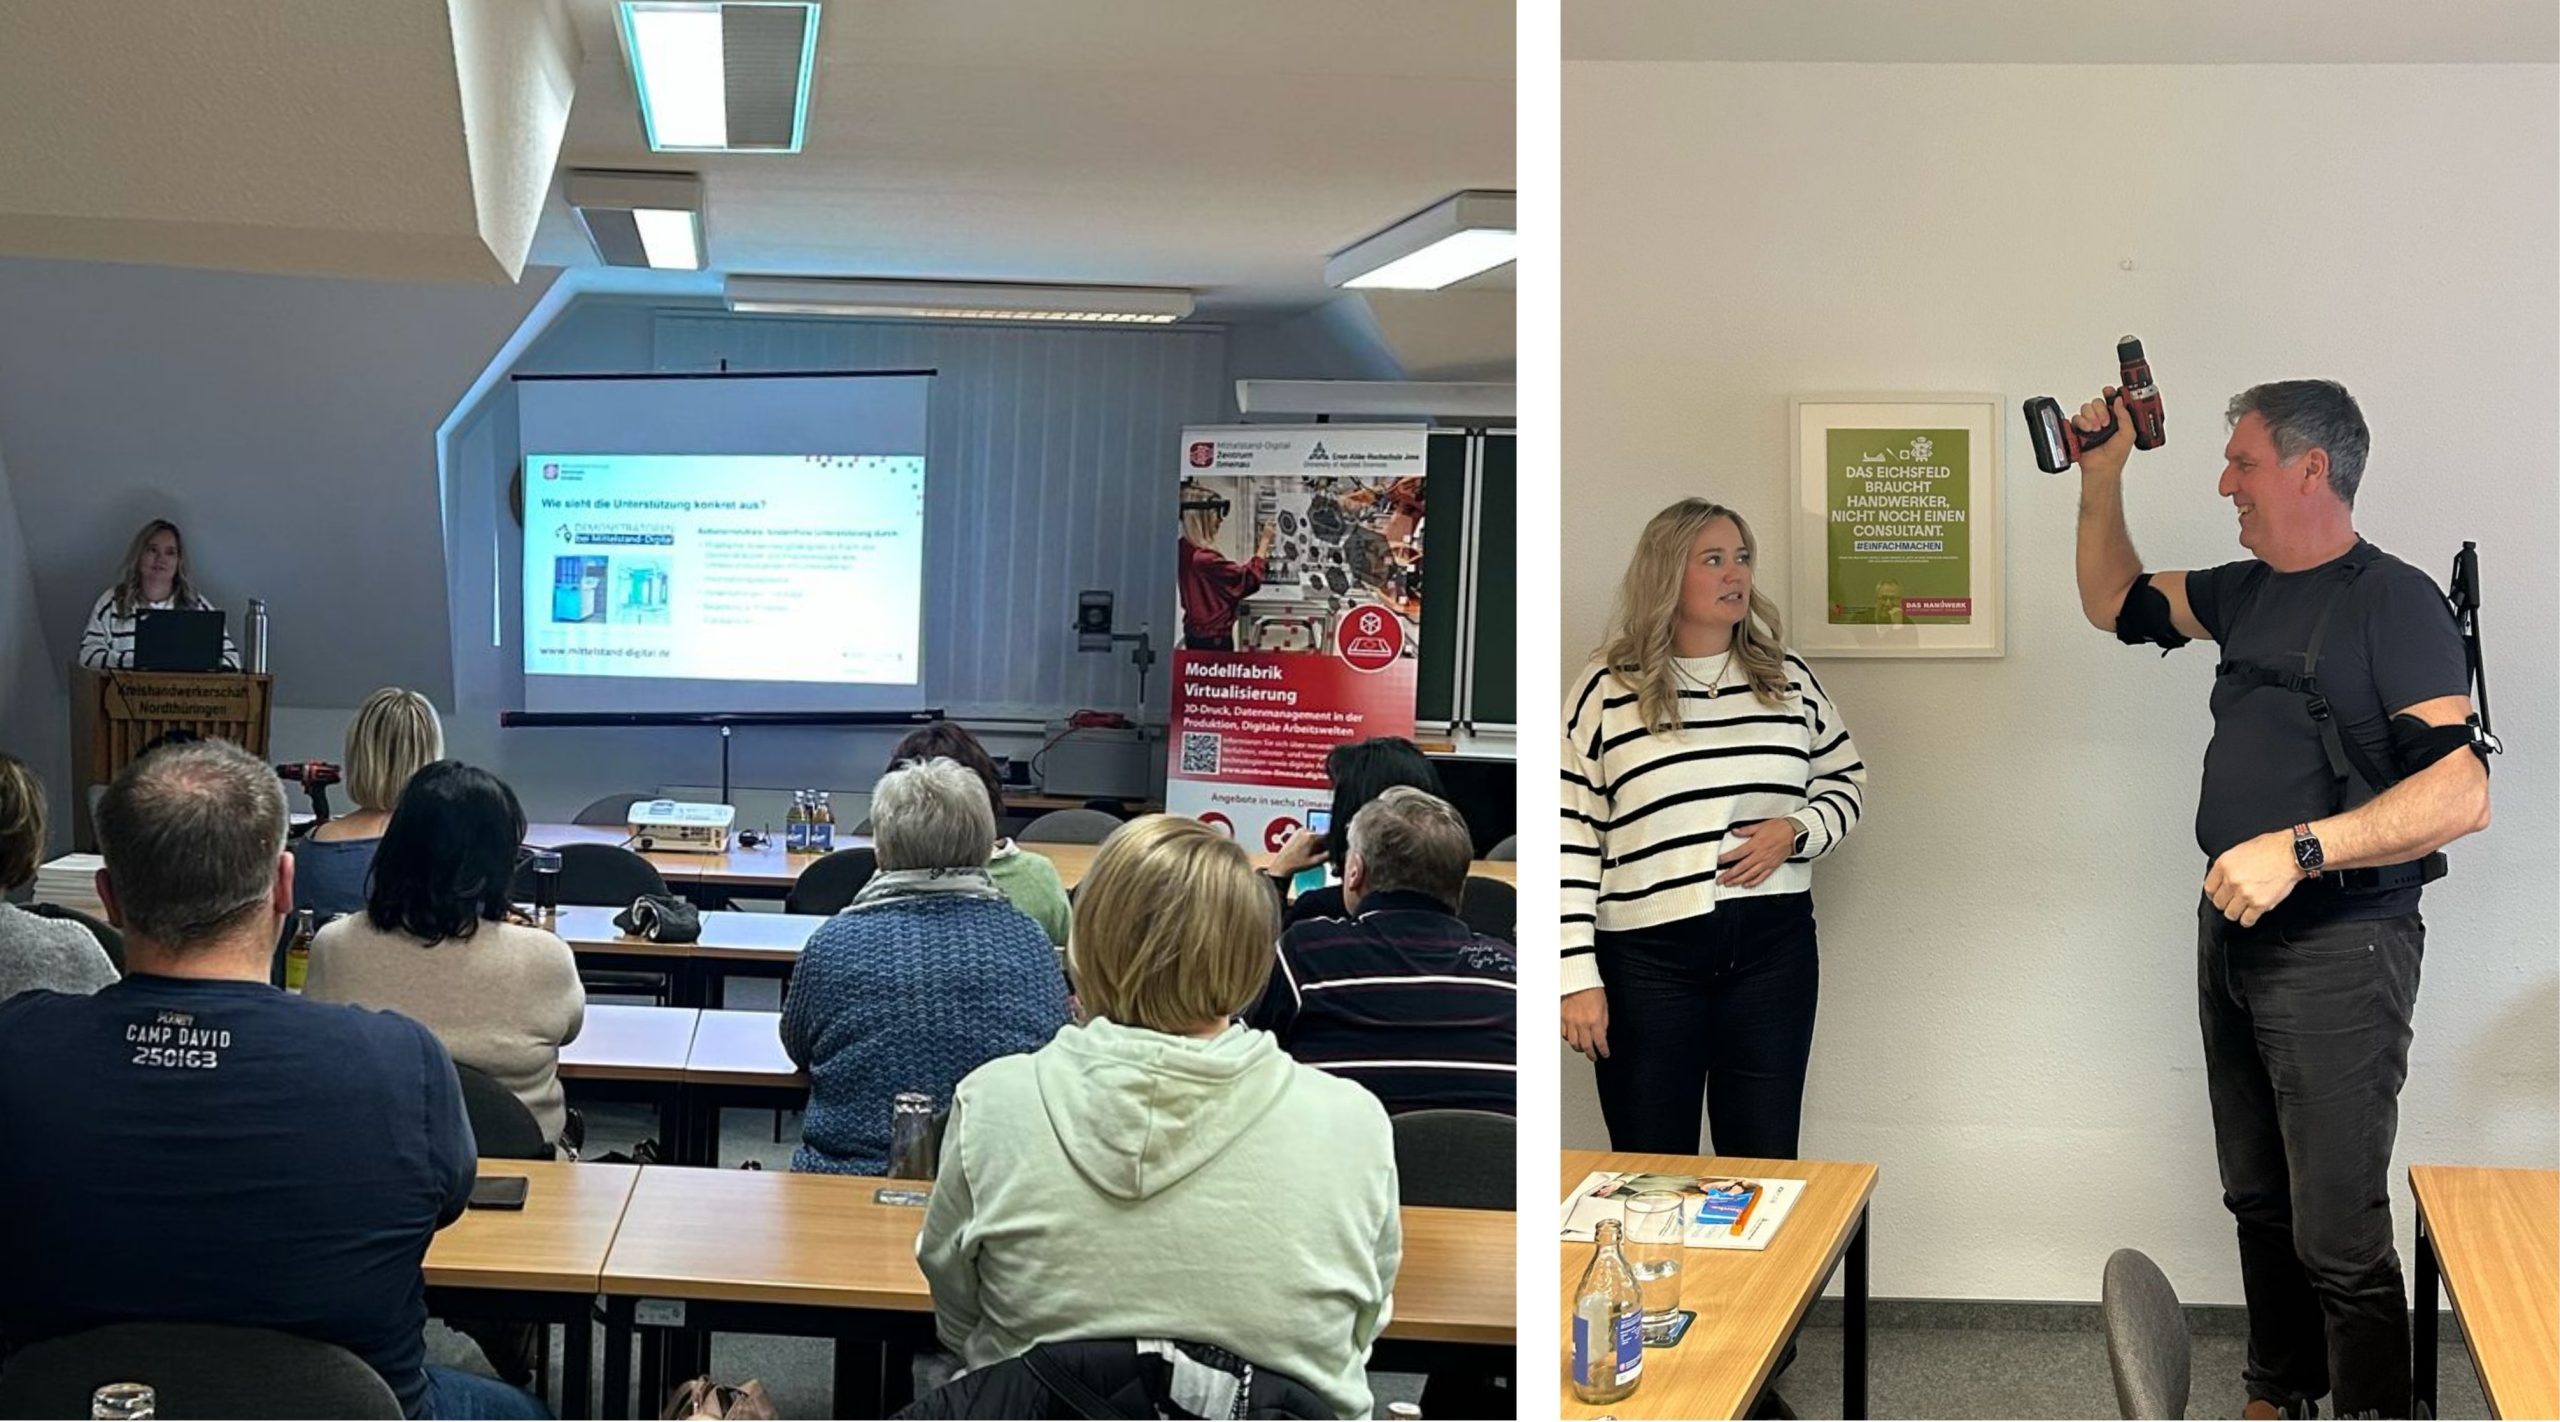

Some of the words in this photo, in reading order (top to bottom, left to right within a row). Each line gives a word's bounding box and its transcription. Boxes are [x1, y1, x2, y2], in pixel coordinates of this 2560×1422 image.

[1216, 442, 1291, 451] Mittelstand-Digital
[1216, 451, 1253, 459] Zentrum
[1846, 466, 1873, 478] DAS
[1877, 466, 1950, 478] EICHSFELD
[1865, 480, 1932, 493] BRAUCHT
[542, 498, 561, 508] Wie
[565, 498, 591, 509] sieht
[594, 498, 611, 509] die
[694, 499, 736, 509] konkret
[1847, 495, 1950, 509] HANDWERKER,
[1832, 510, 1875, 522] NICHT
[1879, 510, 1920, 523] NOCH
[1925, 510, 1965, 522] EINEN
[1853, 525, 1944, 537] CONSULTANT.
[1856, 542, 1942, 551] #EINFACHMACHEN
[1924, 600, 1967, 609] HANDWERK
[1185, 662, 1283, 680] Modellfabrik
[119, 683, 248, 698] Kreishandwerkerschaft
[1184, 683, 1297, 704] Virtualisierung
[139, 702, 227, 717] Nordthüringen
[1184, 704, 1231, 716] 3D-Druck,
[1234, 705, 1332, 722] Datenmanagement
[1334, 711, 1344, 721] in
[1346, 712, 1363, 722] der
[1183, 716, 1239, 730] Produktion,
[1241, 721, 1280, 734] Digitale
[1283, 723, 1354, 736] Arbeitswelten
[1212, 793, 1257, 805] Angebote
[1259, 795, 1268, 804] in
[1270, 796, 1295, 807] sechs
[126, 1023, 172, 1044] CAMP
[178, 1028, 231, 1048] DAVID
